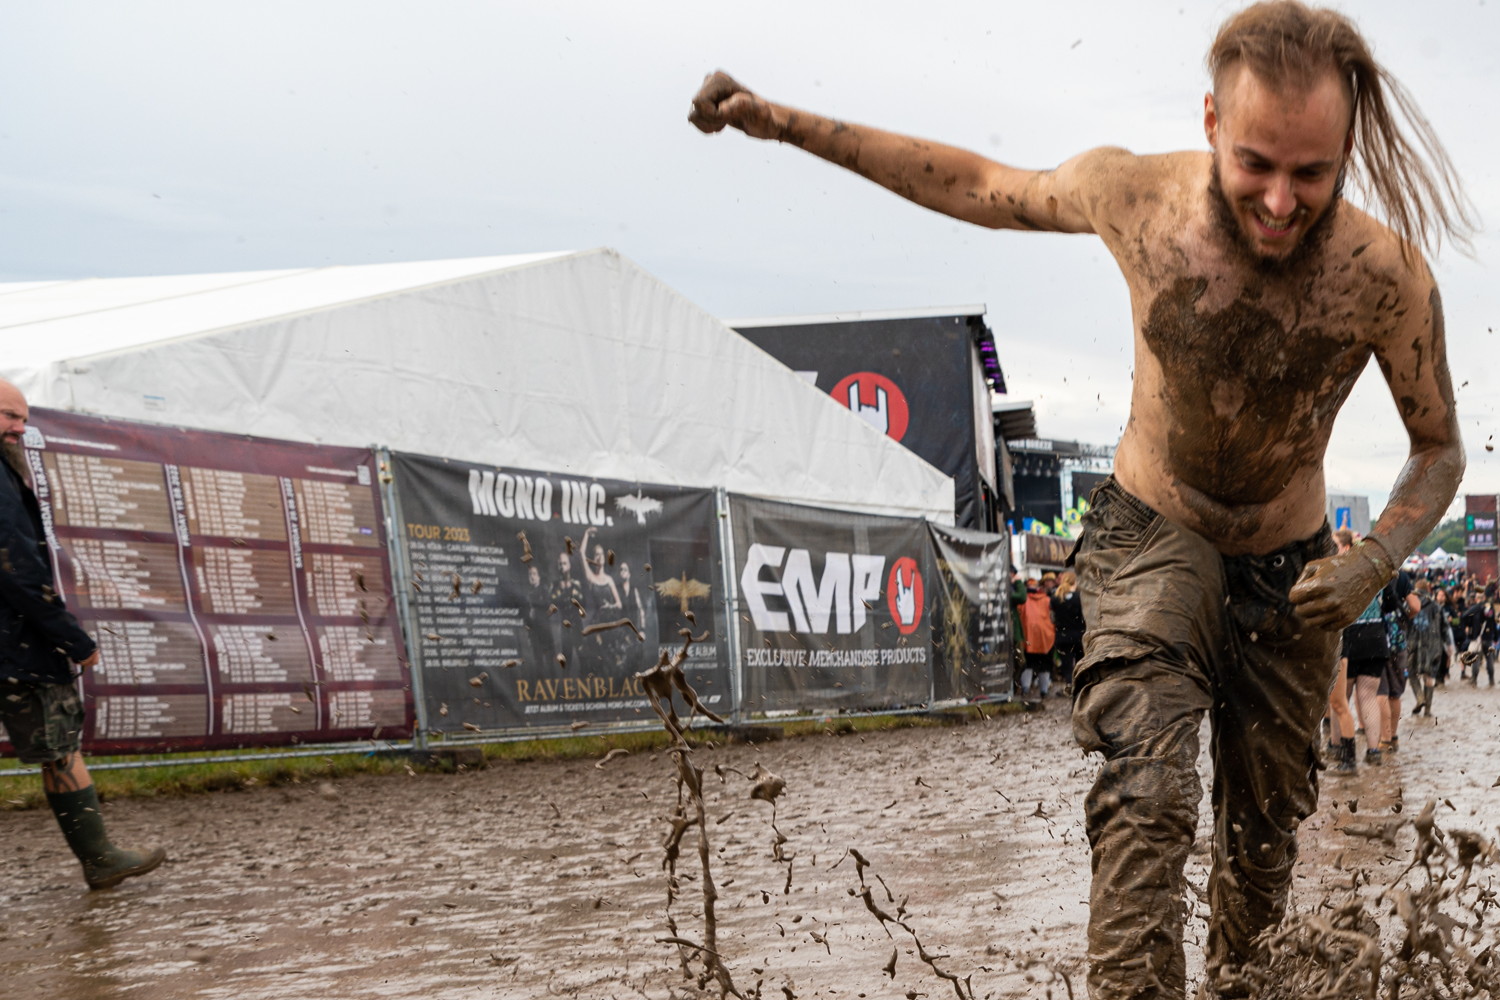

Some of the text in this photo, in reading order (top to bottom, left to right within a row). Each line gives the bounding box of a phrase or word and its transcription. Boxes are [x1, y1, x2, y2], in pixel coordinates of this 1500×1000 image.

[468, 469, 614, 526] MONO INC.
[407, 524, 441, 539] TOUR
[740, 543, 886, 634] EMP
[808, 649, 881, 668] MERCHANDISE
[880, 647, 926, 666] PRODUCTS
[516, 675, 648, 703] RAVENBLAC
